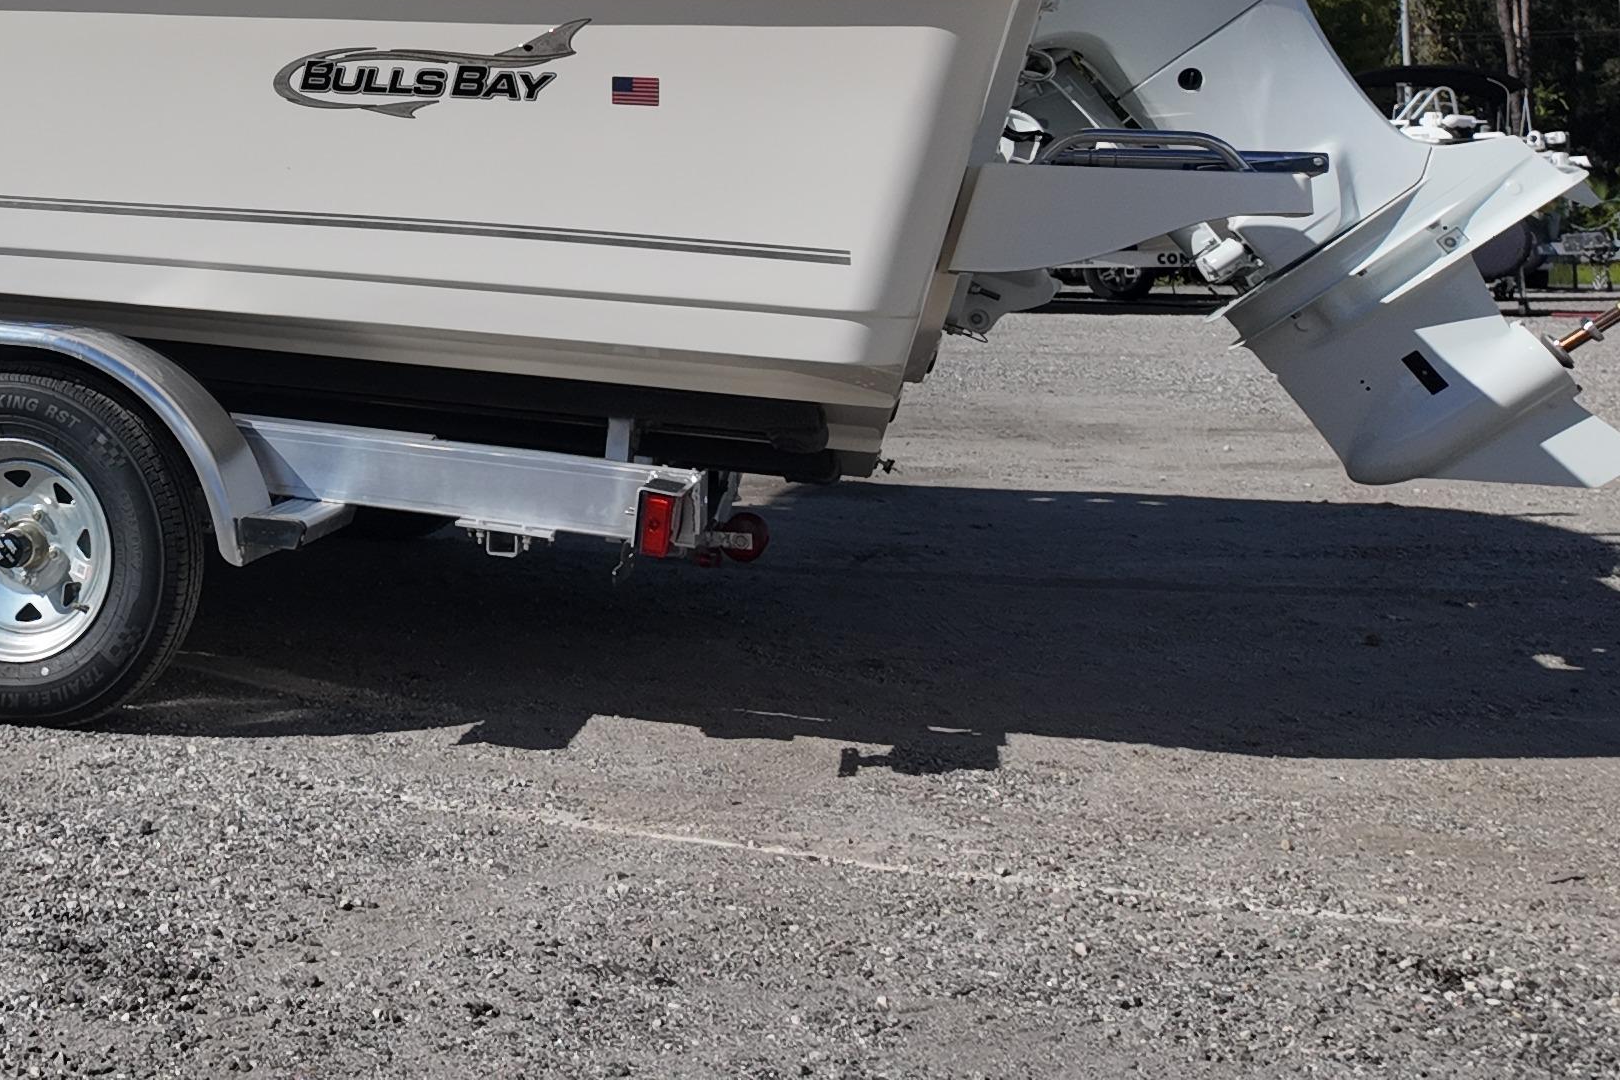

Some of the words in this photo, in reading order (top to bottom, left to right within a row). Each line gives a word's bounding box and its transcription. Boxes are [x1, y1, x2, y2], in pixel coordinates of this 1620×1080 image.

[299, 58, 448, 97] BULLS
[450, 64, 557, 102] BAY
[44, 404, 81, 430] RST
[27, 665, 105, 707] TRAILER
